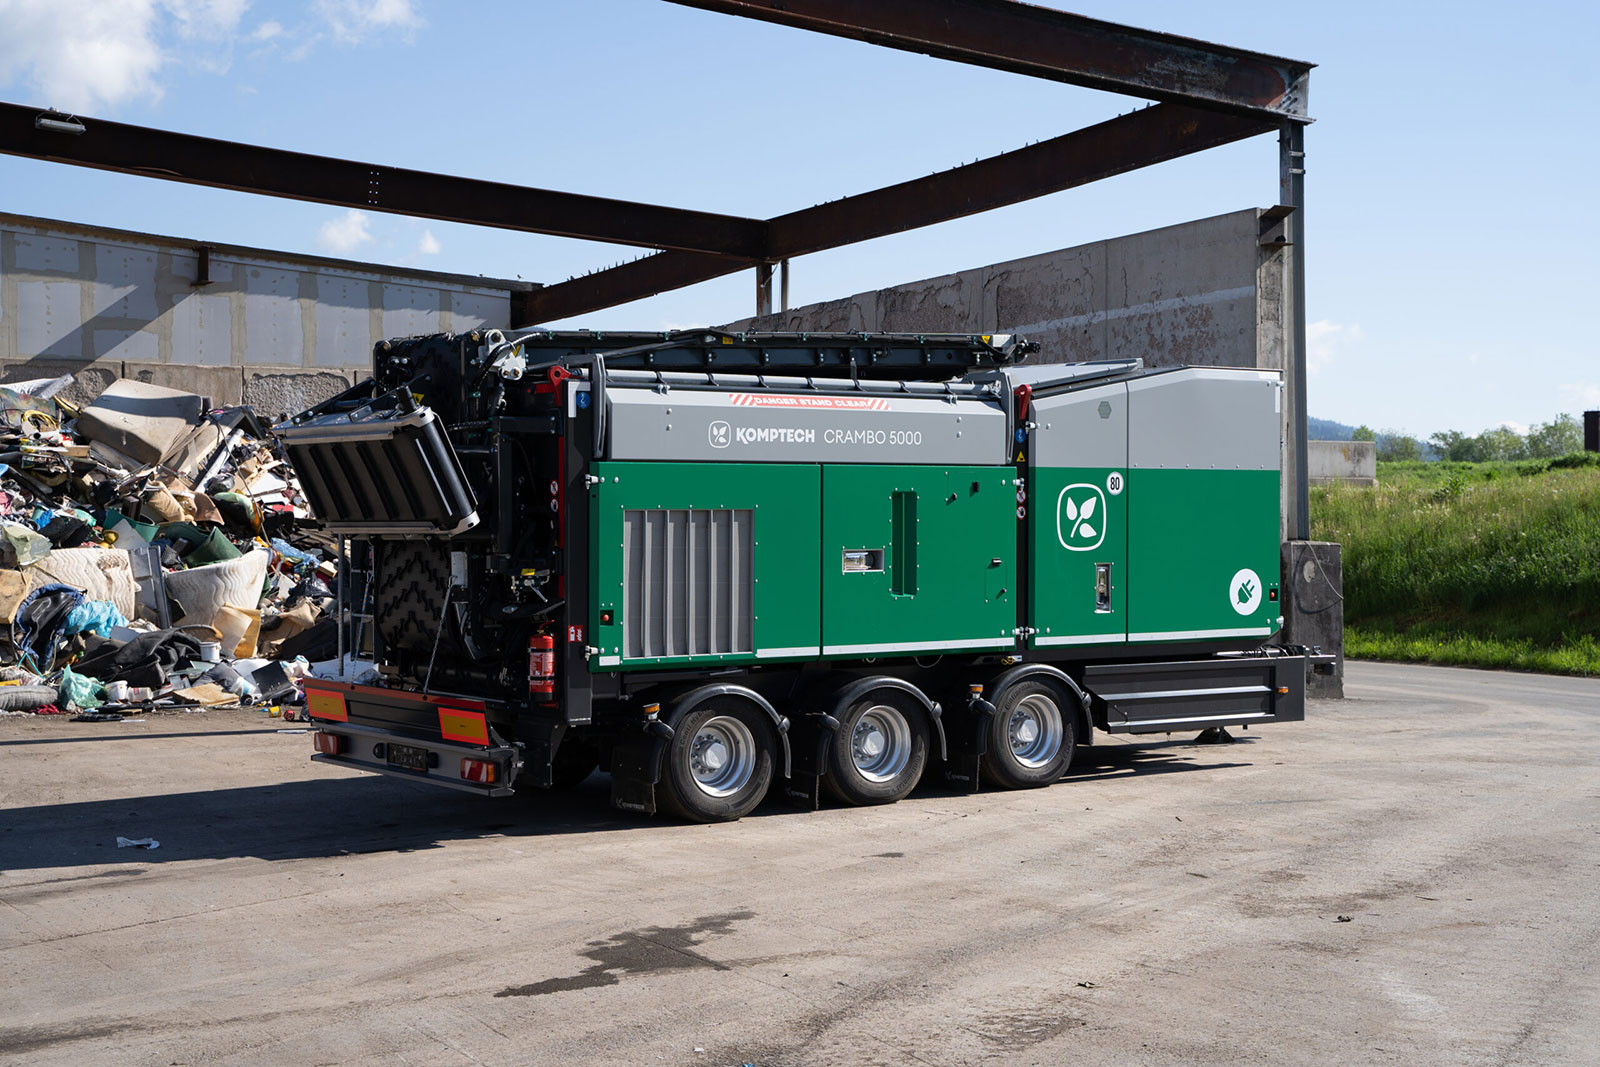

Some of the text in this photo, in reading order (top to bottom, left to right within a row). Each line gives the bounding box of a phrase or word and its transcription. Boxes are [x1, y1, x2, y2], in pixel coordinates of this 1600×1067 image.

[754, 397, 868, 408] DANGER STAND CLEAR
[736, 427, 922, 445] KOMPTECH CRAMBO 5000
[1110, 476, 1121, 491] 80
